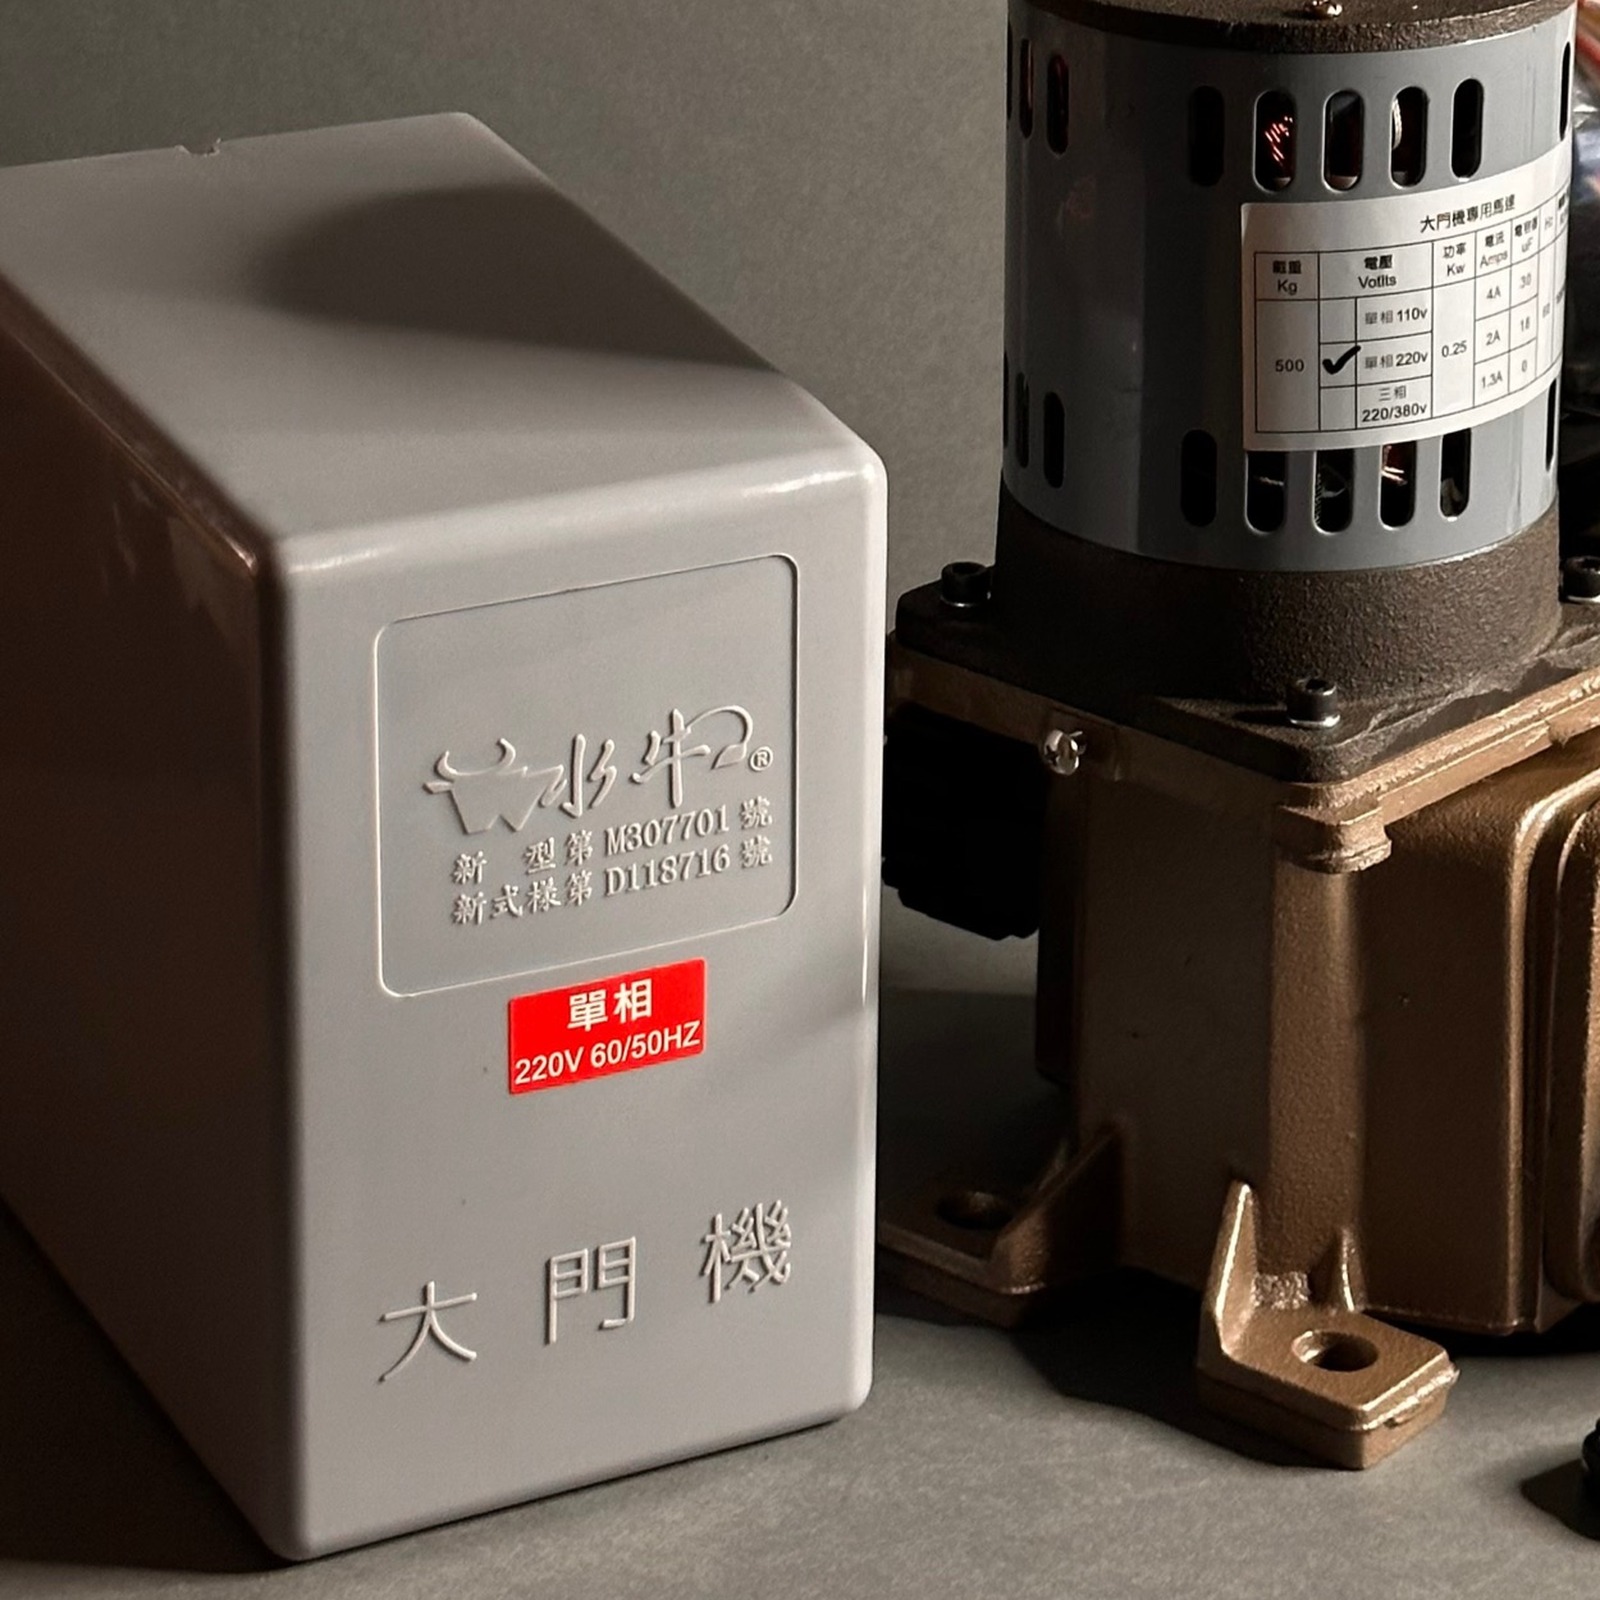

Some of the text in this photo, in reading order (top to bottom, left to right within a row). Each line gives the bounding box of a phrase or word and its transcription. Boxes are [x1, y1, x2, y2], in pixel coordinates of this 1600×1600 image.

[1447, 263, 1465, 277] Kw
[1277, 280, 1298, 296] Kg
[1486, 286, 1501, 299] 4A
[1486, 330, 1500, 346] 2A
[1441, 340, 1467, 358] 0.25
[1275, 359, 1305, 372] 500
[1482, 371, 1503, 388] 1.3A
[1378, 385, 1407, 401] 三相
[605, 804, 731, 858] M307701
[605, 843, 731, 898] D118716
[567, 978, 653, 1032] 單相
[514, 1020, 701, 1086] 220V 60/50HZ
[377, 1199, 793, 1384] 大門機
